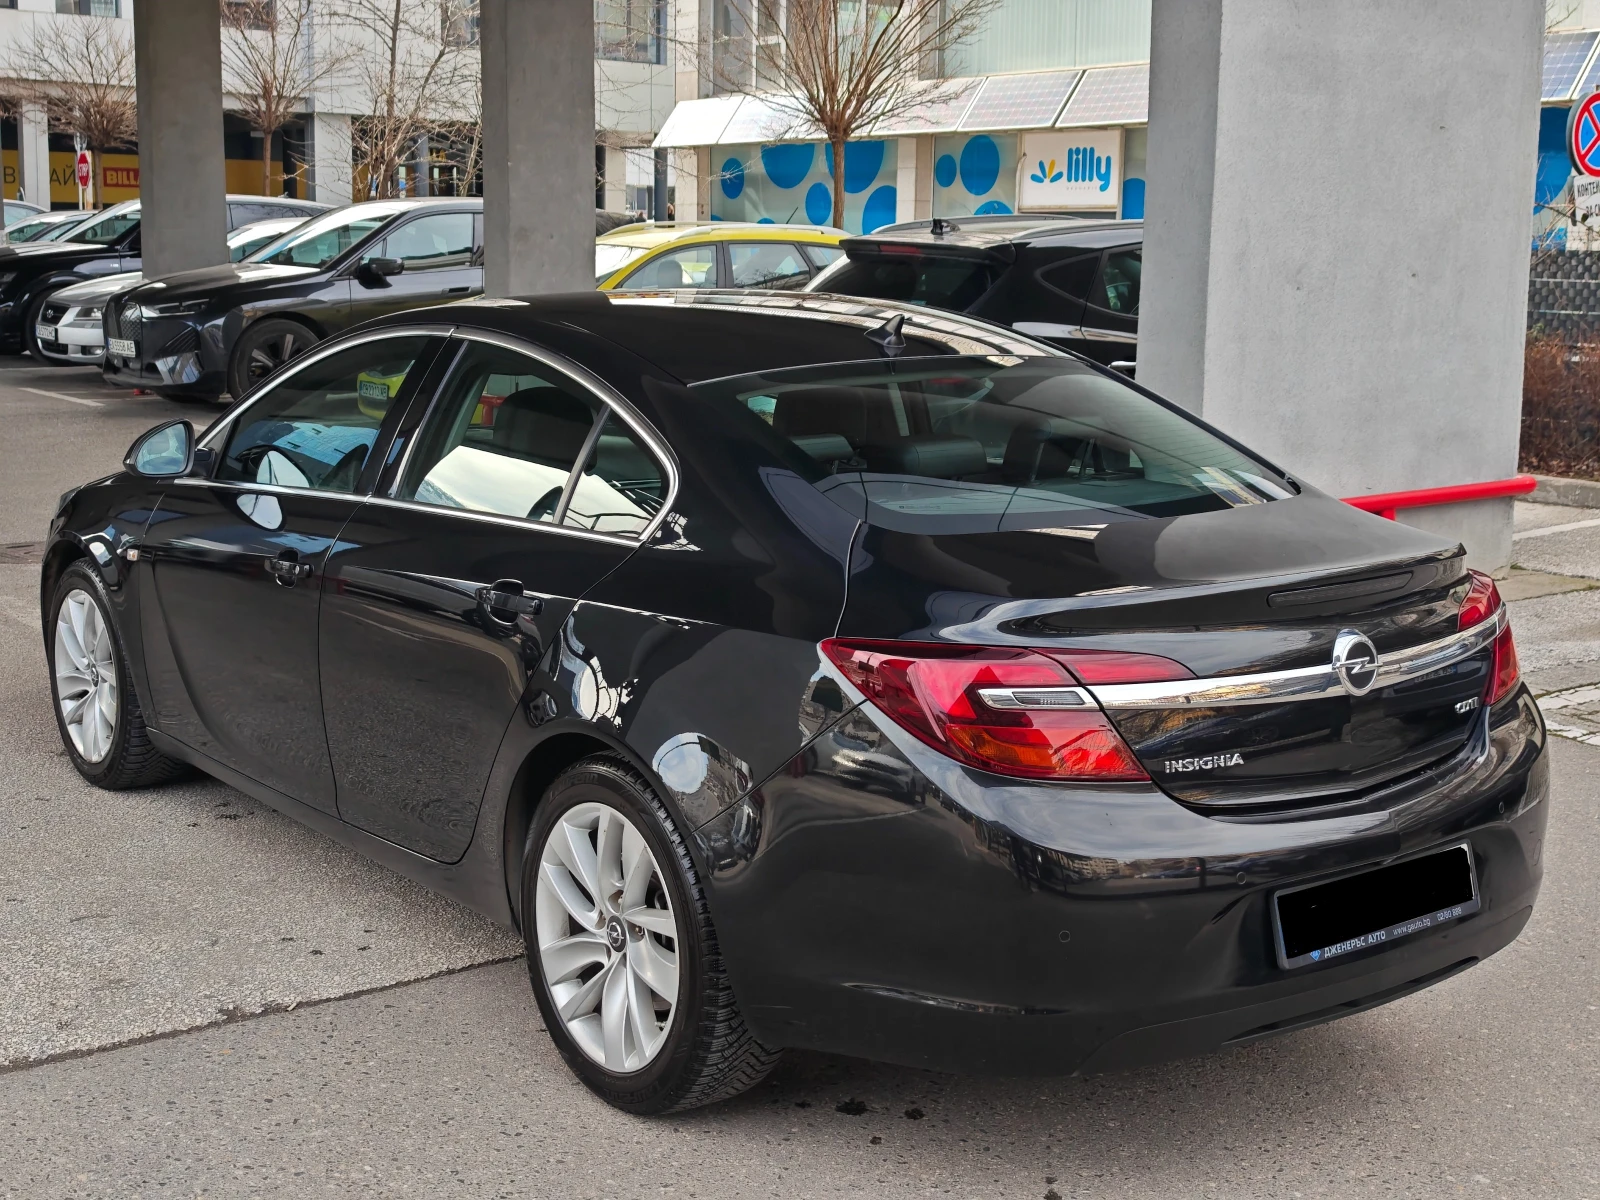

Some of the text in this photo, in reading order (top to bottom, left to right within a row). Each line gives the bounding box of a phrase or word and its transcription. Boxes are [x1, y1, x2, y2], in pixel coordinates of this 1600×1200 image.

[78, 163, 89, 177] STOP
[106, 170, 139, 185] BILL
[1067, 146, 1112, 192] lilly
[1164, 753, 1245, 774] INSIGNIA
[1324, 936, 1366, 959] ДЖЕНЕРЪС
[1368, 930, 1386, 944] АУТО
